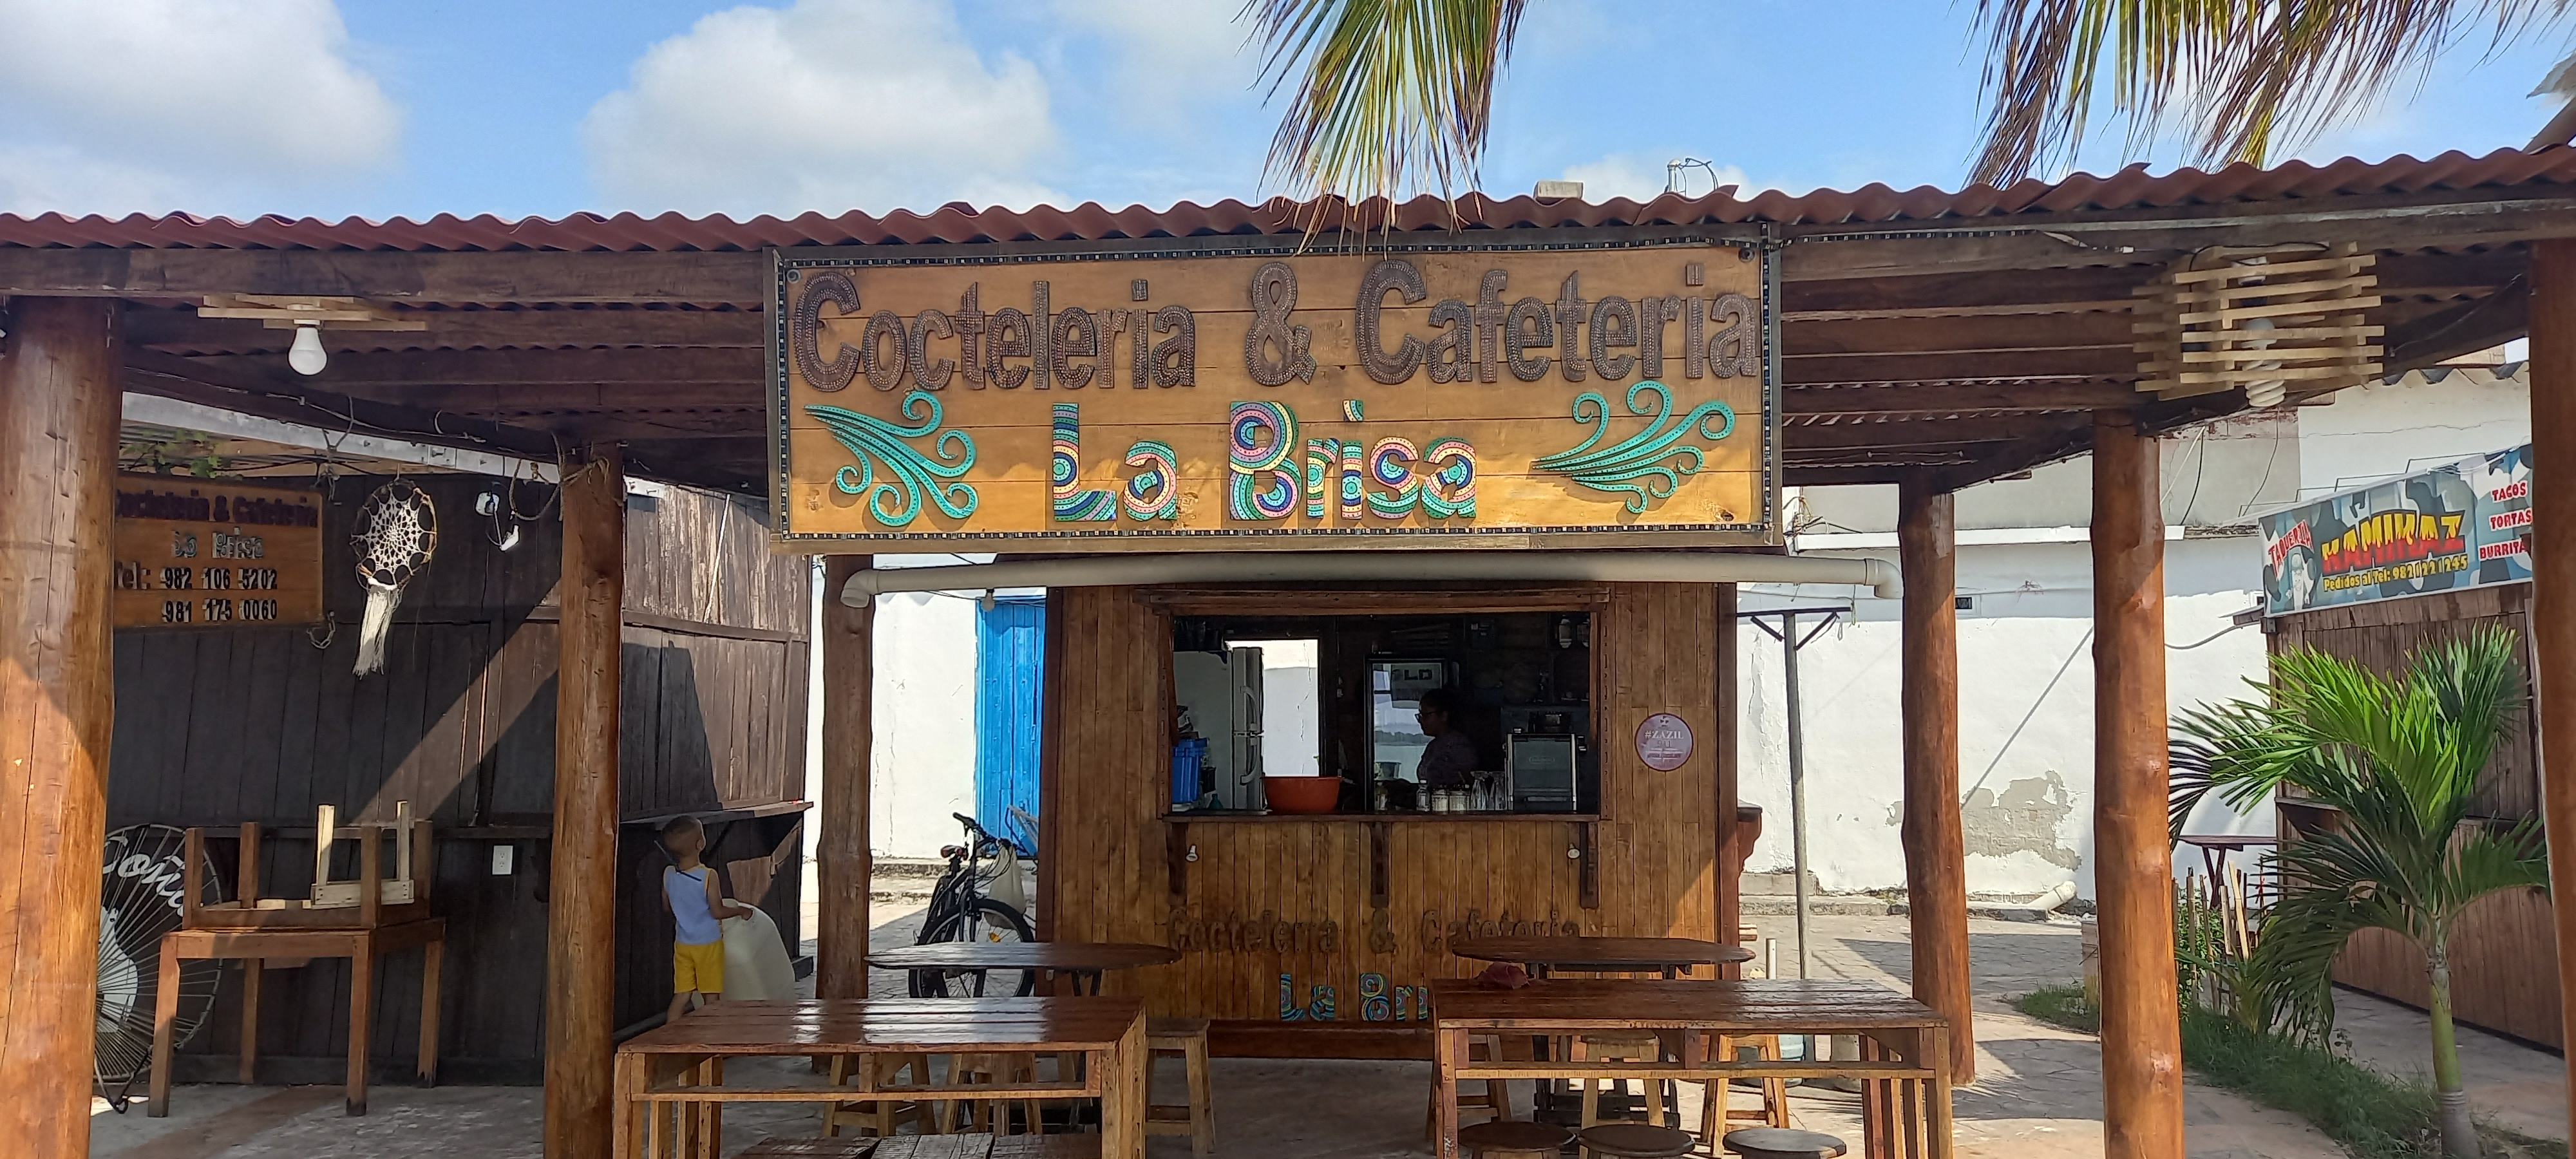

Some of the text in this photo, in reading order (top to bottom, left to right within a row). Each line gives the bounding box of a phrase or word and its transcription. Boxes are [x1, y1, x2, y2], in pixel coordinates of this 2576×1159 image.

[793, 259, 1759, 391] Cocteleria & Cafeteria
[1052, 400, 1477, 522] La Brisa
[2491, 482, 2526, 502] TACOS
[2490, 509, 2532, 530] TORTAS
[2268, 520, 2314, 578] TAQUERIA
[2321, 513, 2463, 567] KAMIKAZ
[2479, 540, 2527, 560] BURRITA
[163, 567, 193, 589] 982
[202, 567, 231, 589] 106
[238, 567, 278, 589] 5202
[2324, 574, 2361, 592] Pedidos
[2362, 570, 2372, 586] al
[2372, 567, 2391, 584] Tel:
[163, 598, 278, 622] 981 175 0060
[1372, 909, 1396, 954] &
[1280, 972, 1428, 1022] La Bri
